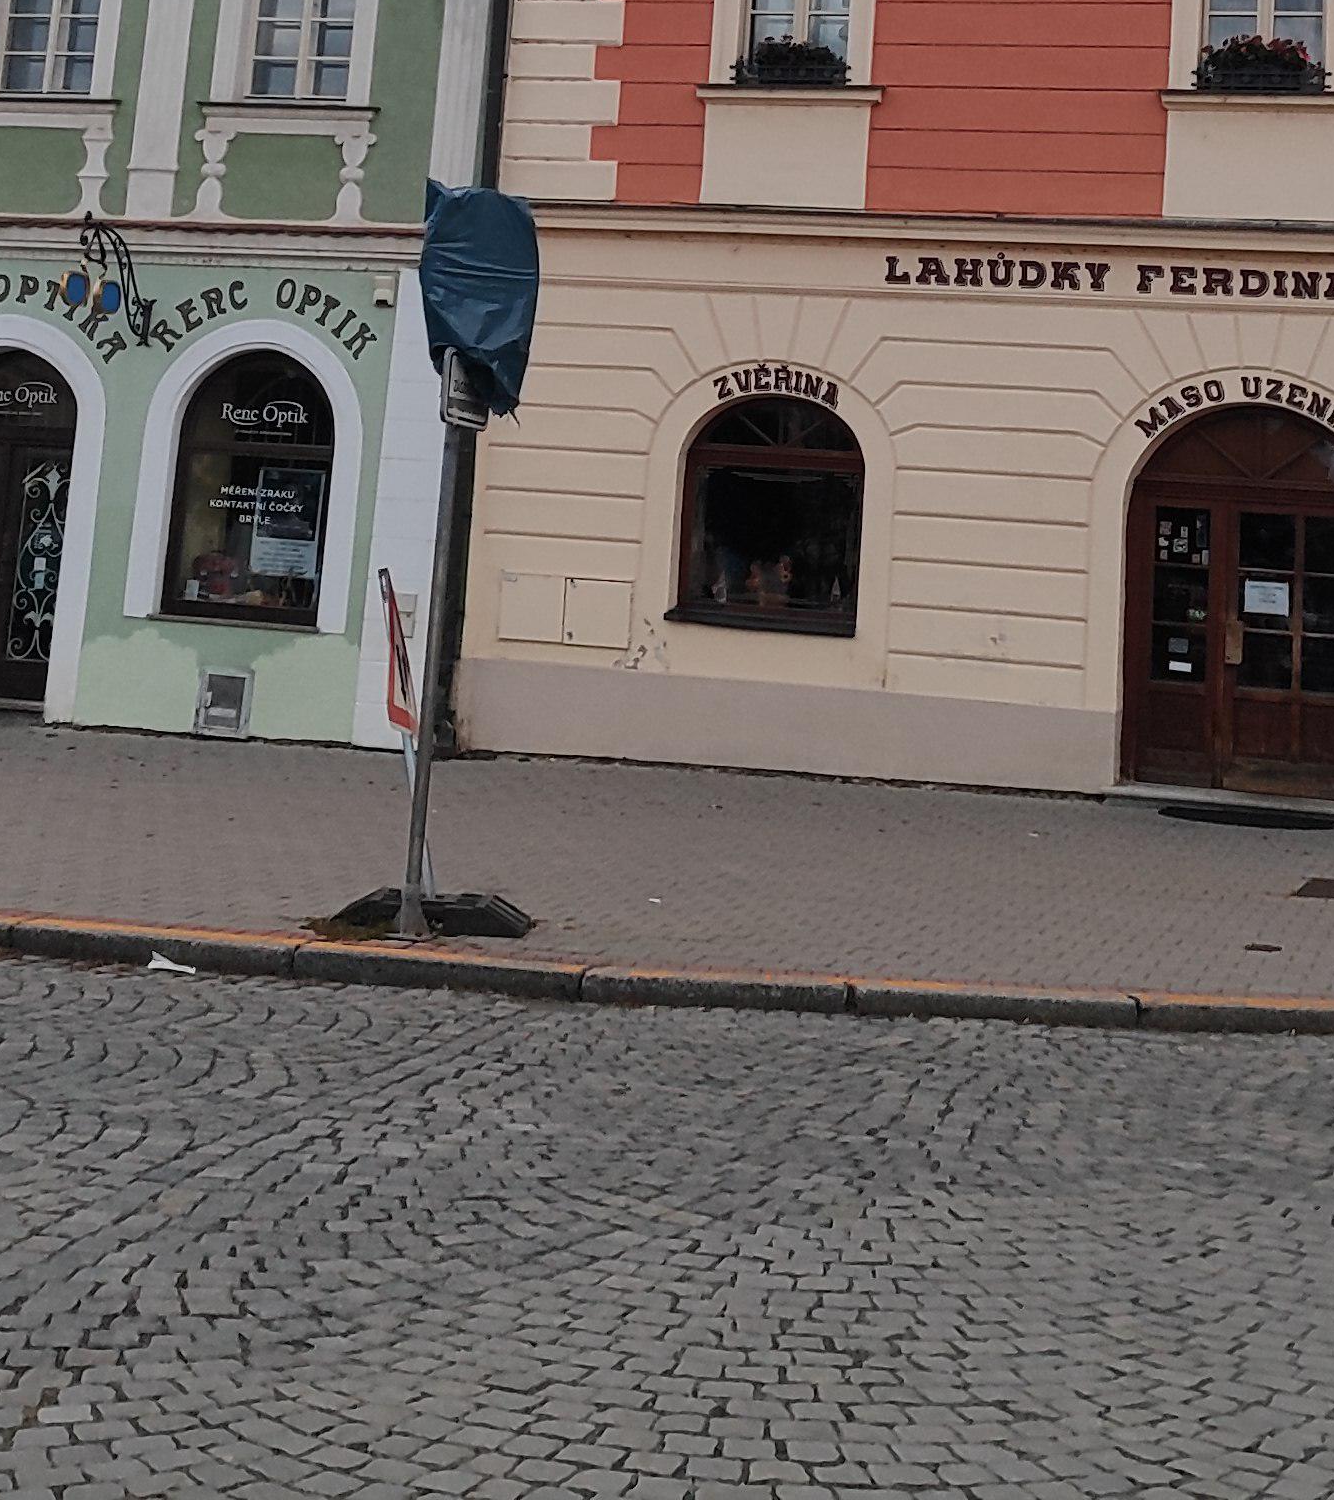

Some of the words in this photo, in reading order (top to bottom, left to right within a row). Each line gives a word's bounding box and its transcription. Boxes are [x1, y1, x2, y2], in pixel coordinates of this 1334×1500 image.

[884, 252, 1111, 292] LAHŮDKY
[149, 280, 248, 353] RENC
[276, 278, 378, 361] OPTIK
[15, 382, 59, 408] Optik
[713, 364, 839, 410] ZVĚŘINA
[221, 403, 262, 426] Renc
[263, 401, 309, 428] Optik
[1134, 379, 1225, 440] MASO
